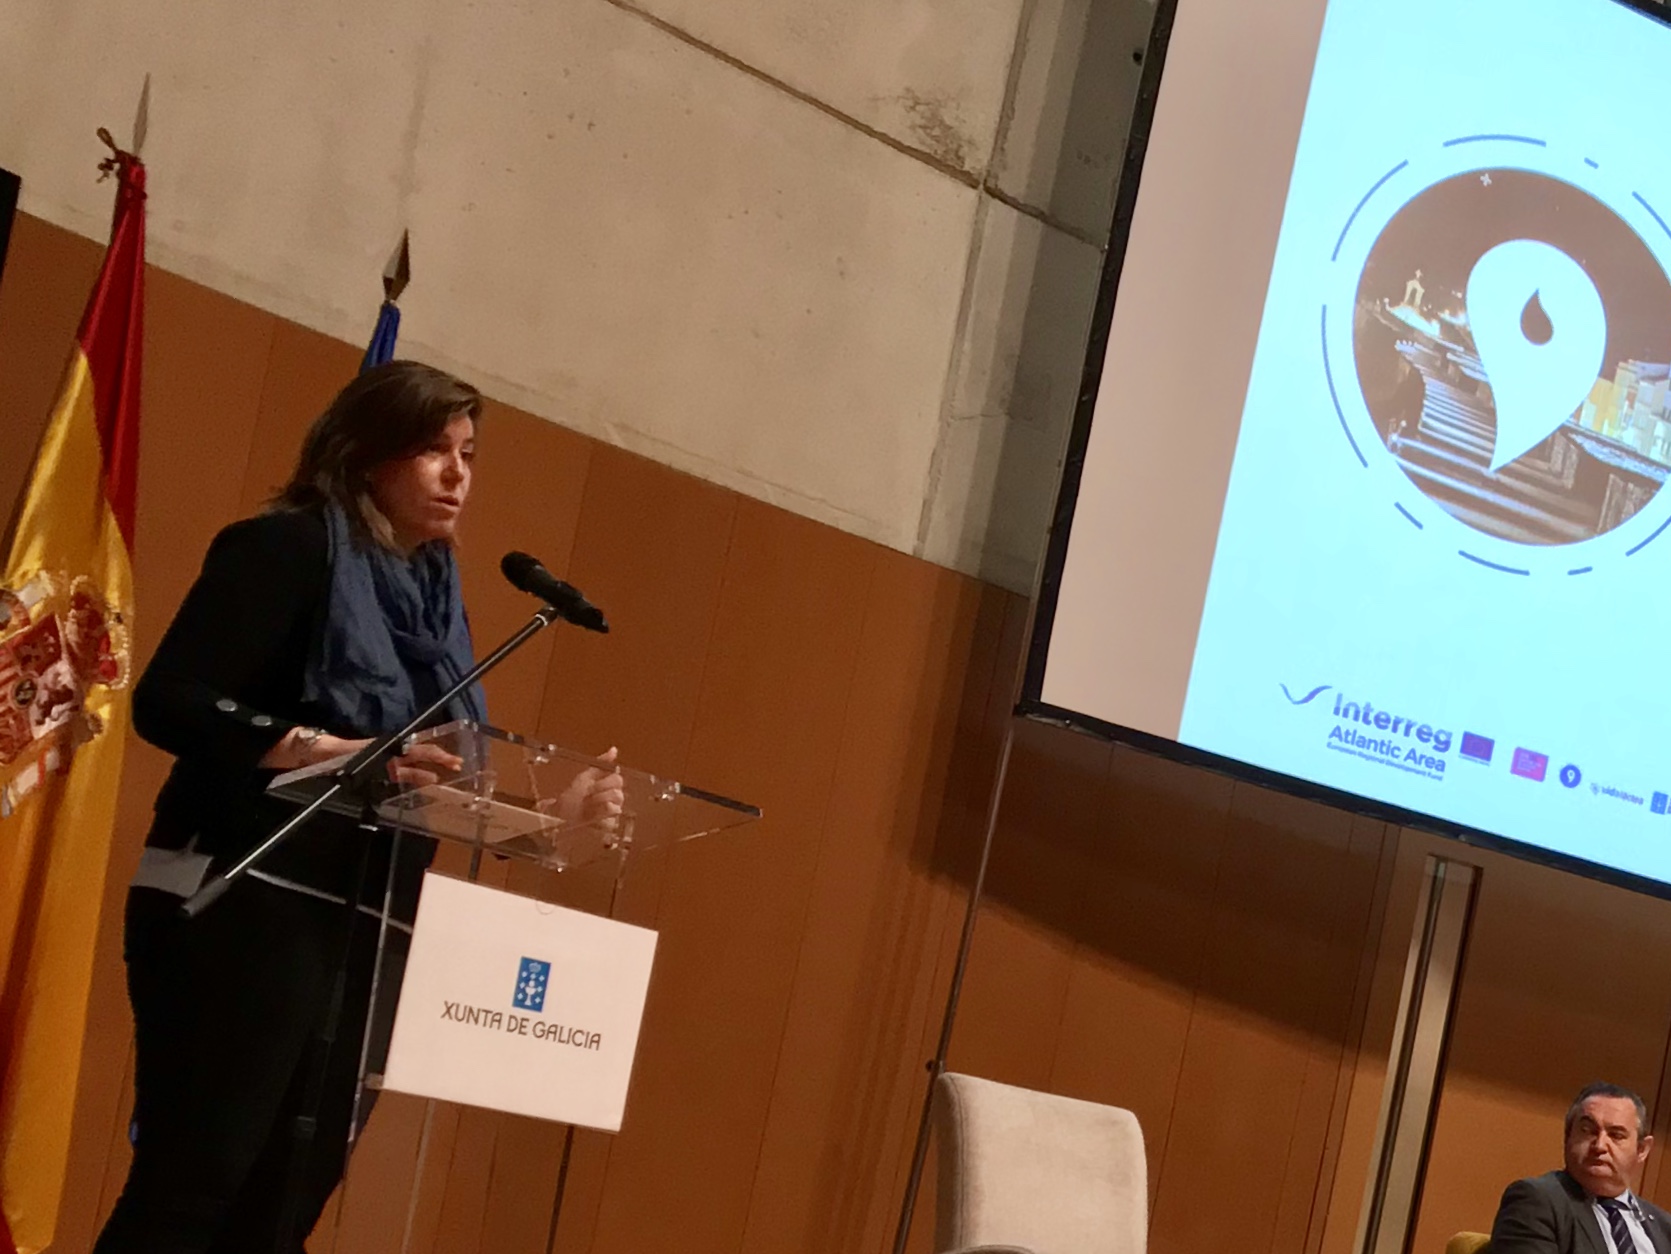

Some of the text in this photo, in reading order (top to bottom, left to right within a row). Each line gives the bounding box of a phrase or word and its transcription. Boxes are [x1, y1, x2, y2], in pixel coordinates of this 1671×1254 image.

[1328, 724, 1446, 773] Atlantic Area
[1332, 692, 1453, 754] Interreg
[440, 1000, 602, 1051] XUNTA DE GALICIA
